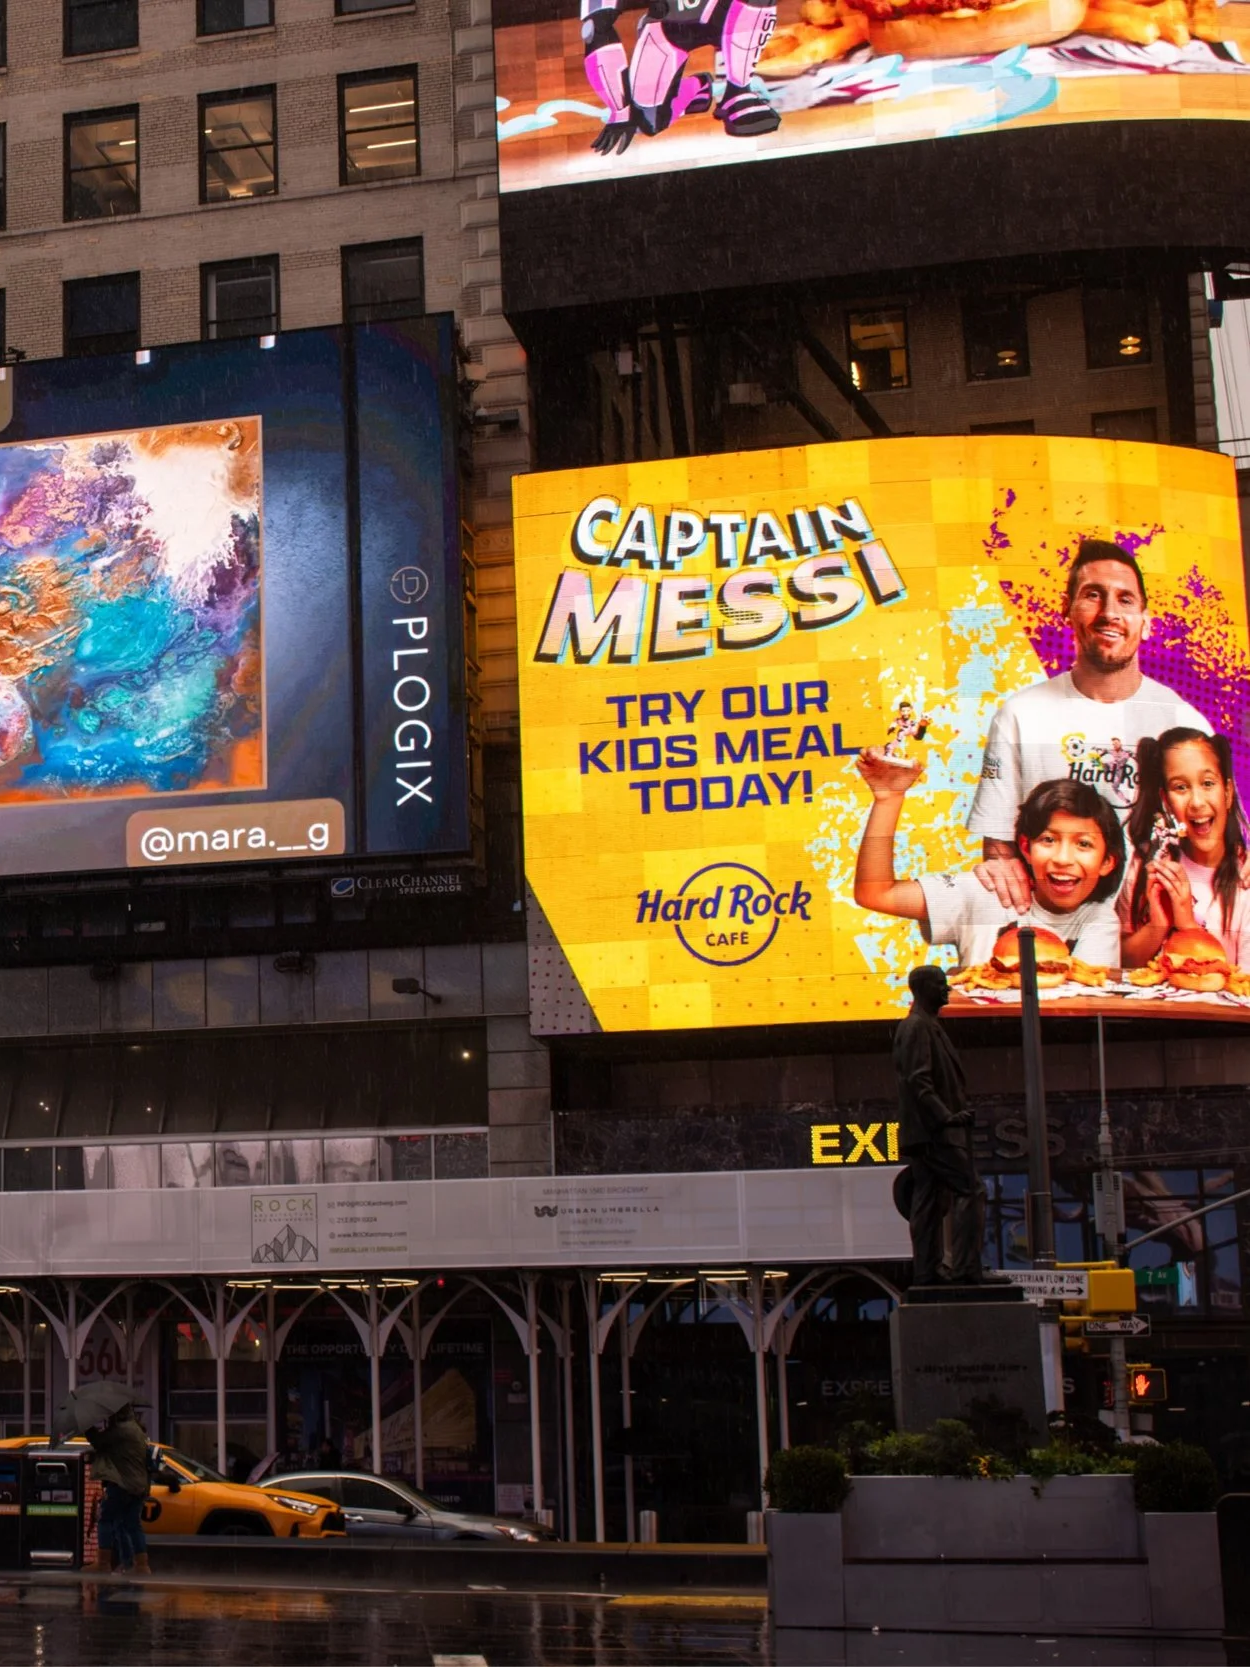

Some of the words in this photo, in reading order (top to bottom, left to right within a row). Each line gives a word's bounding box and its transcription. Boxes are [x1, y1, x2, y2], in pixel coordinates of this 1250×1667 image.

[572, 494, 872, 568] CAPTAIN
[535, 539, 906, 664] MESSI
[392, 616, 432, 806] PLOGIX
[606, 690, 705, 729] TRY
[722, 680, 829, 720] OUR
[579, 734, 697, 775] KIDS
[715, 723, 865, 765] MEAL
[629, 770, 813, 814] TODAY!
[636, 885, 724, 923] Hard
[729, 881, 811, 925] Rock
[254, 1199, 312, 1212] ROCK
[1088, 1320, 1109, 1331] ONE
[1118, 1320, 1141, 1331] WAY
